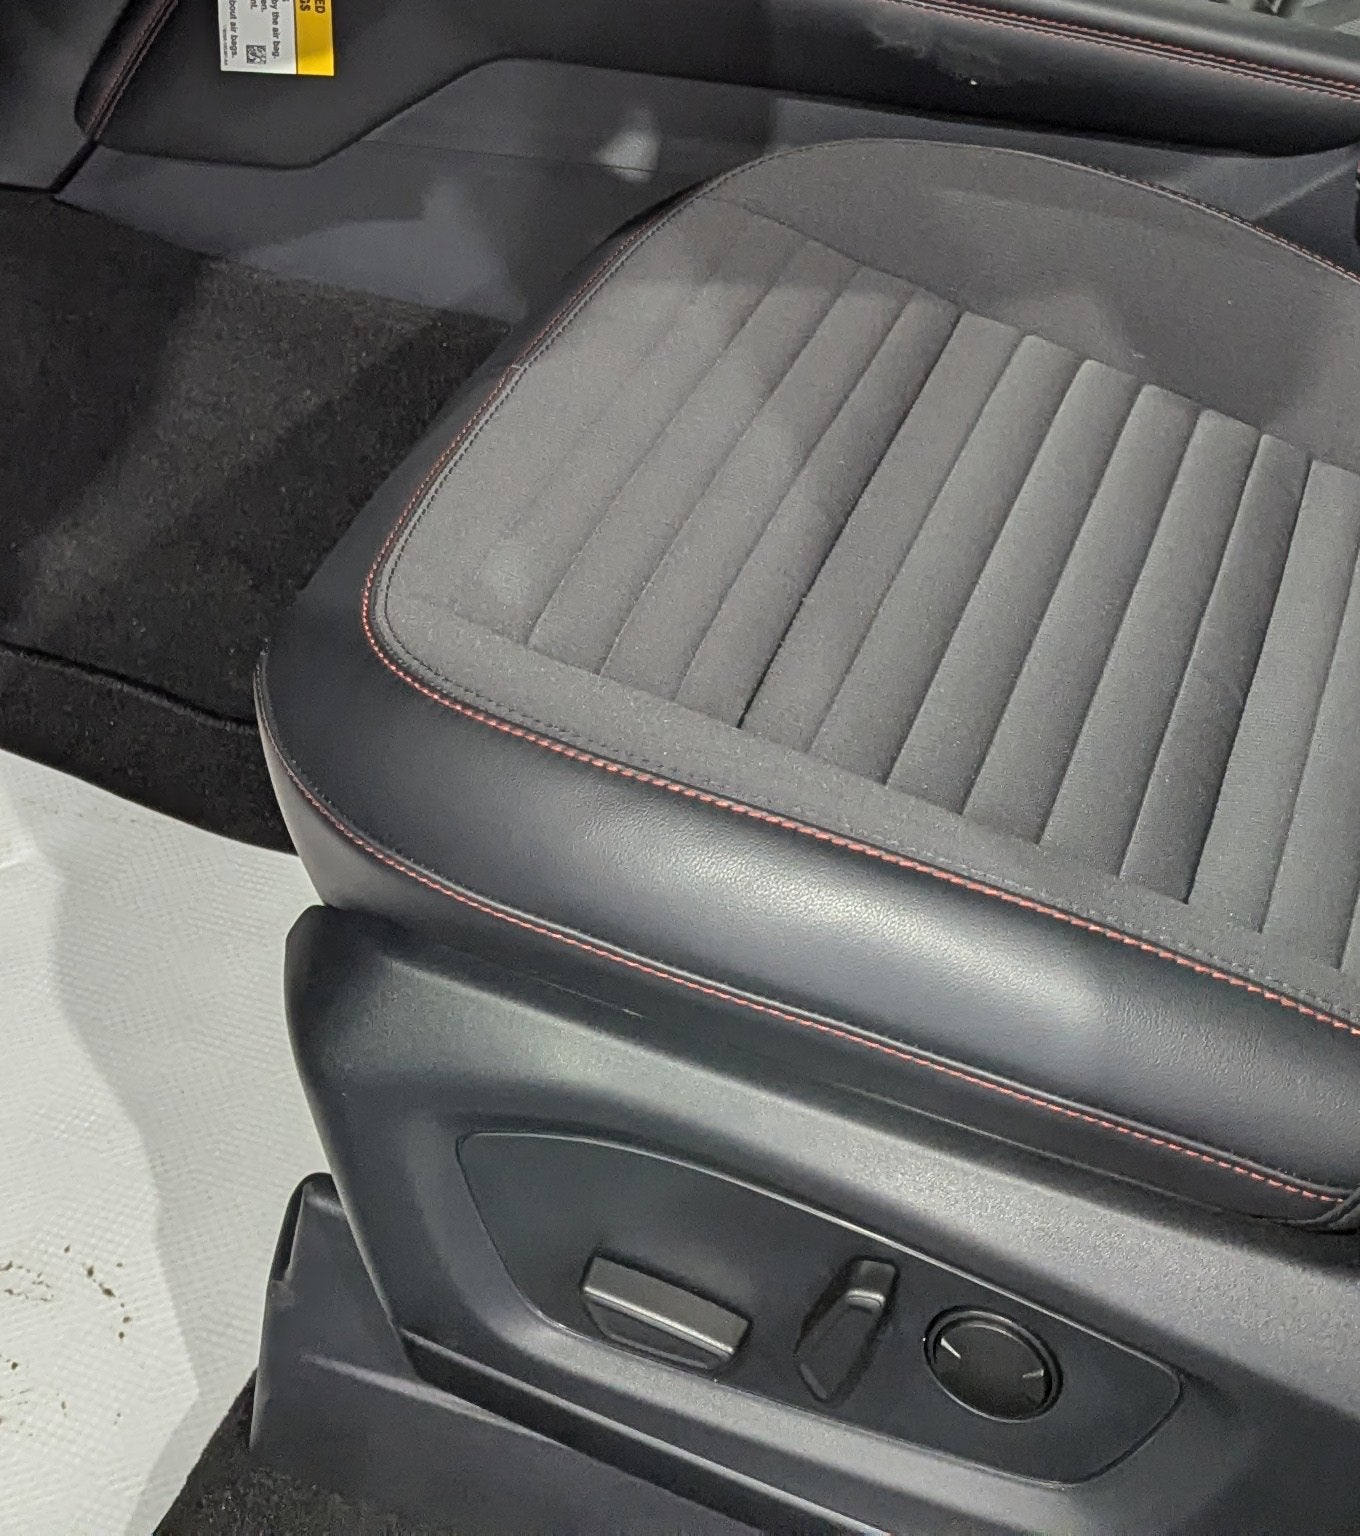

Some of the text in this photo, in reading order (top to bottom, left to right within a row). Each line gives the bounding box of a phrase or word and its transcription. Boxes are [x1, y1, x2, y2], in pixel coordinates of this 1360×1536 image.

[271, 11, 280, 26] the
[230, 21, 238, 34] air
[272, 27, 280, 39] air
